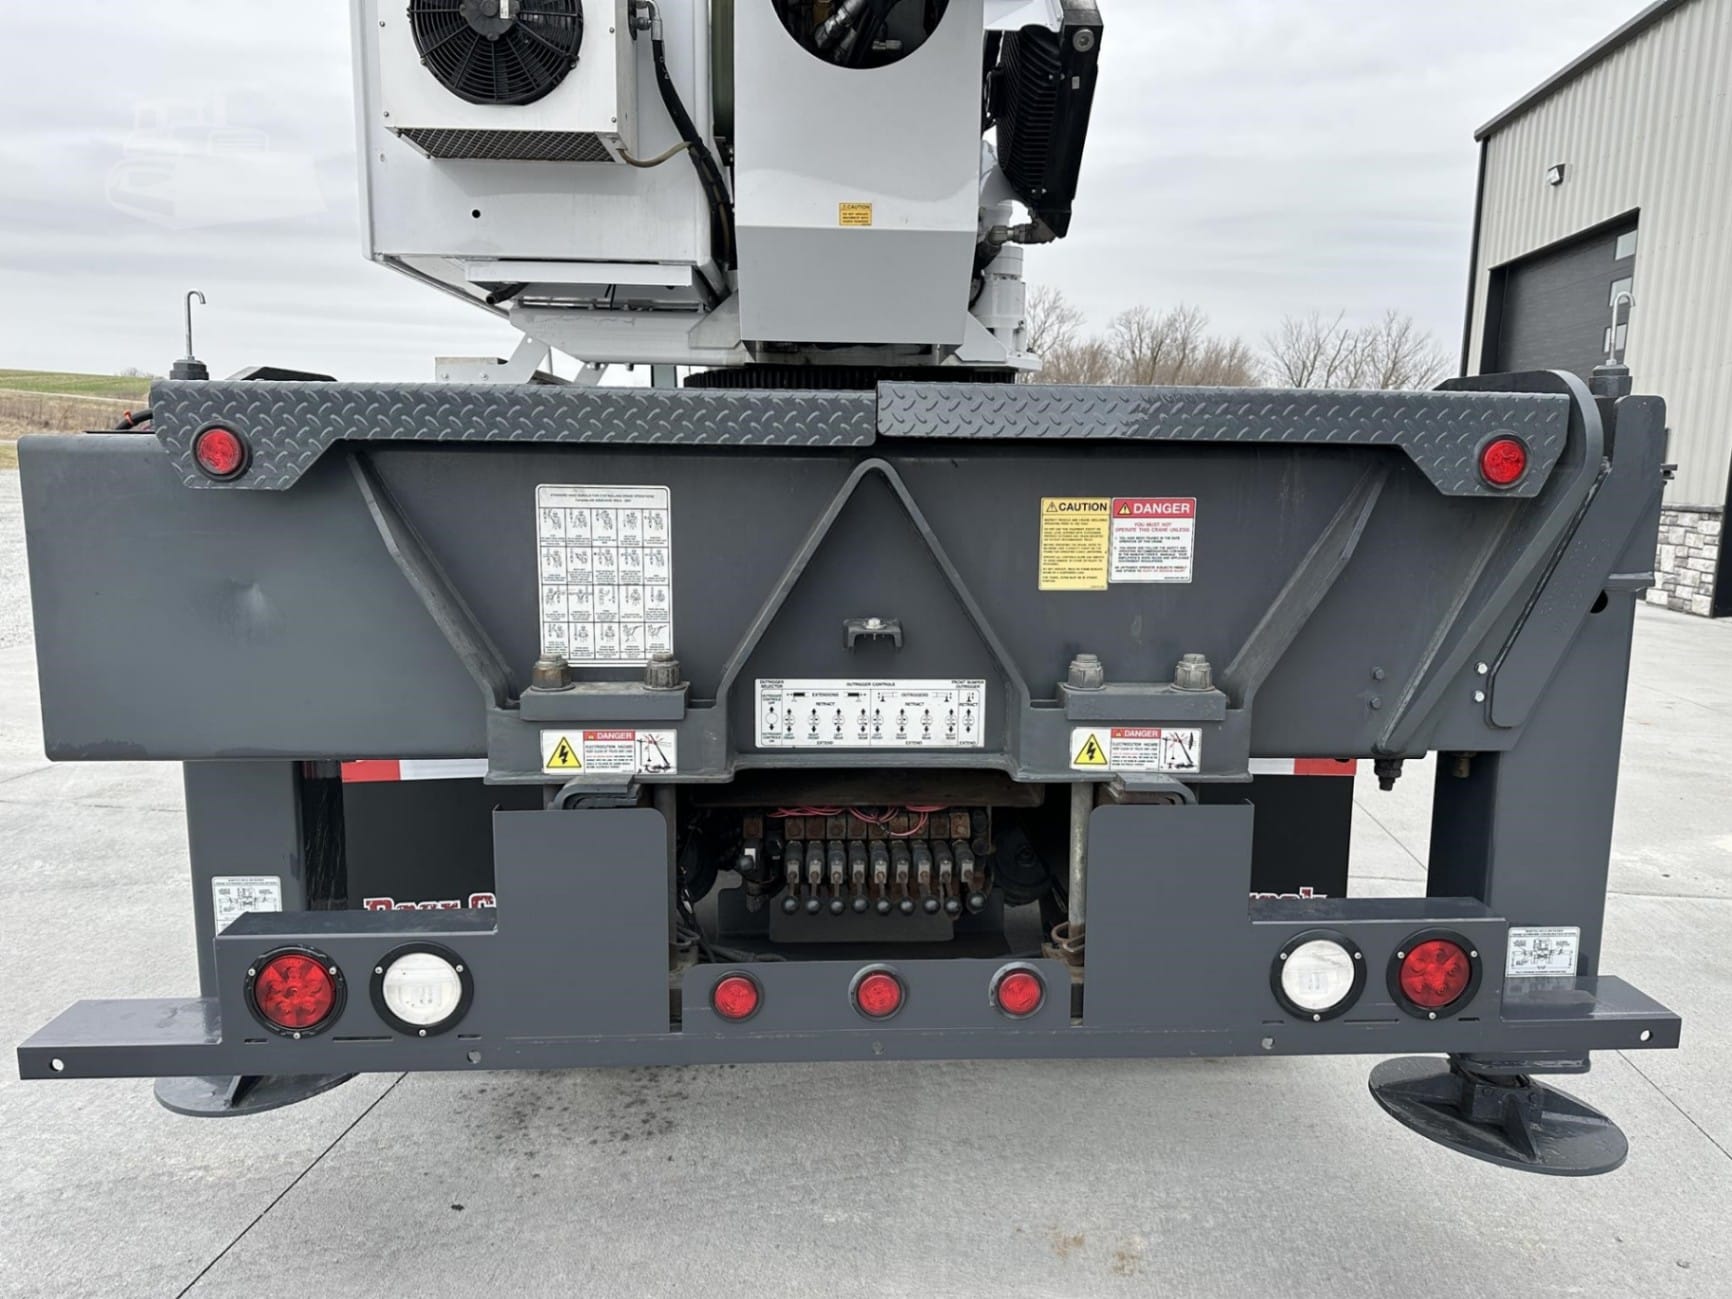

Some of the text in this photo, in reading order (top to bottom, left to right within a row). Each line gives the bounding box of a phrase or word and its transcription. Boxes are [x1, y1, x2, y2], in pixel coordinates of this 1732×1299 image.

[1058, 502, 1107, 511] CAUTION
[1133, 503, 1190, 514] DANGER
[1124, 729, 1158, 737] DANGER
